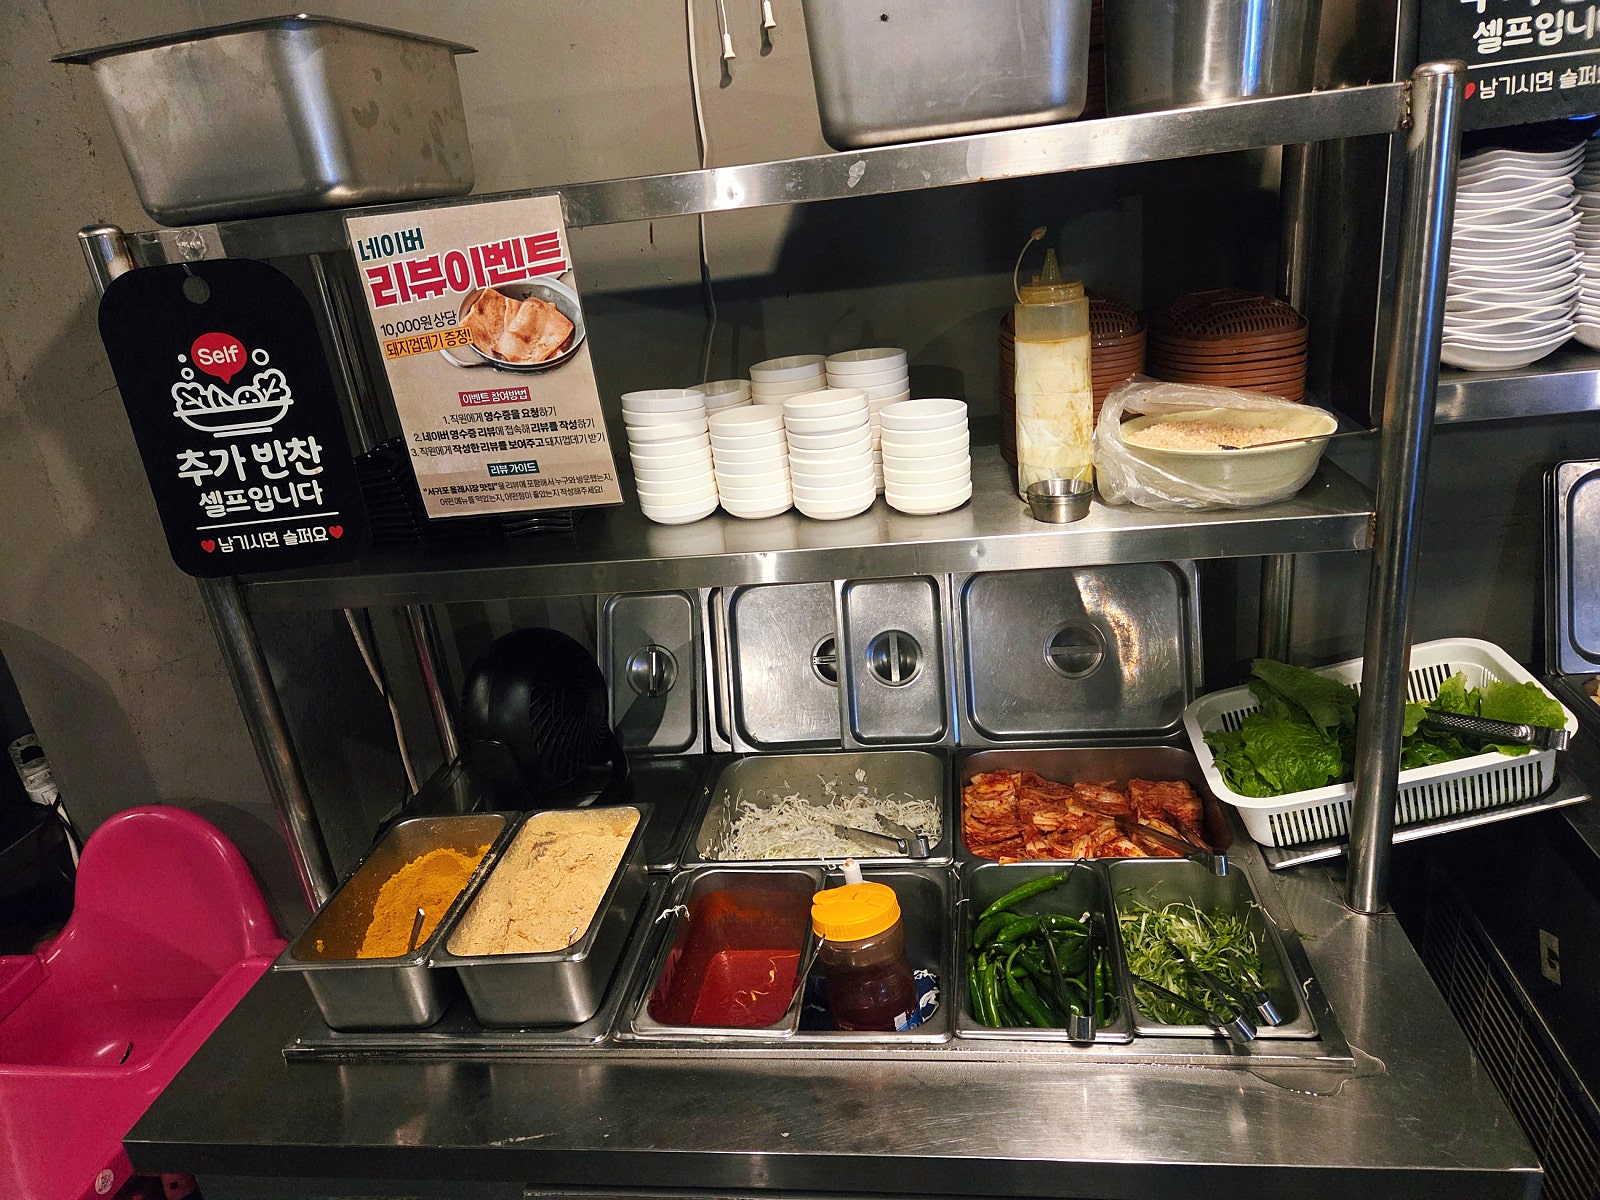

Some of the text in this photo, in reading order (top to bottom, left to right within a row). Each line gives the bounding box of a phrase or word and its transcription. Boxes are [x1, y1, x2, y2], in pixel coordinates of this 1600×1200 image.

[1473, 5, 1600, 54] 셀프입니
[1479, 65, 1600, 100] 남기시면 슬퍼
[357, 228, 425, 261] 네이버
[365, 231, 569, 307] 리뷰이벤트
[380, 311, 457, 337] 10,000원 상당
[197, 345, 240, 366] Self
[386, 331, 473, 356] 돼지껍데기 증정!
[462, 389, 527, 404] 이벤트 참여방법
[449, 411, 483, 424] 직원에게
[483, 408, 520, 422] 영수증을
[521, 406, 557, 418] 요청하기
[421, 430, 449, 442] 네이버
[449, 427, 477, 439] 영수증
[477, 426, 504, 437] 리뷰에
[504, 423, 530, 435] 접속해
[530, 421, 558, 433] 리뷰를
[558, 418, 594, 430] 작성하기
[419, 444, 452, 457] 직원에게
[507, 437, 544, 450] 보여주고
[544, 433, 587, 447] 돼지껍데기
[587, 432, 605, 443] 받기
[177, 436, 324, 486] 추가 반찬
[489, 462, 536, 475] 리뷰 가이드
[199, 480, 323, 517] 셀프입니다
[218, 527, 328, 553] 남기시면 슬퍼요
